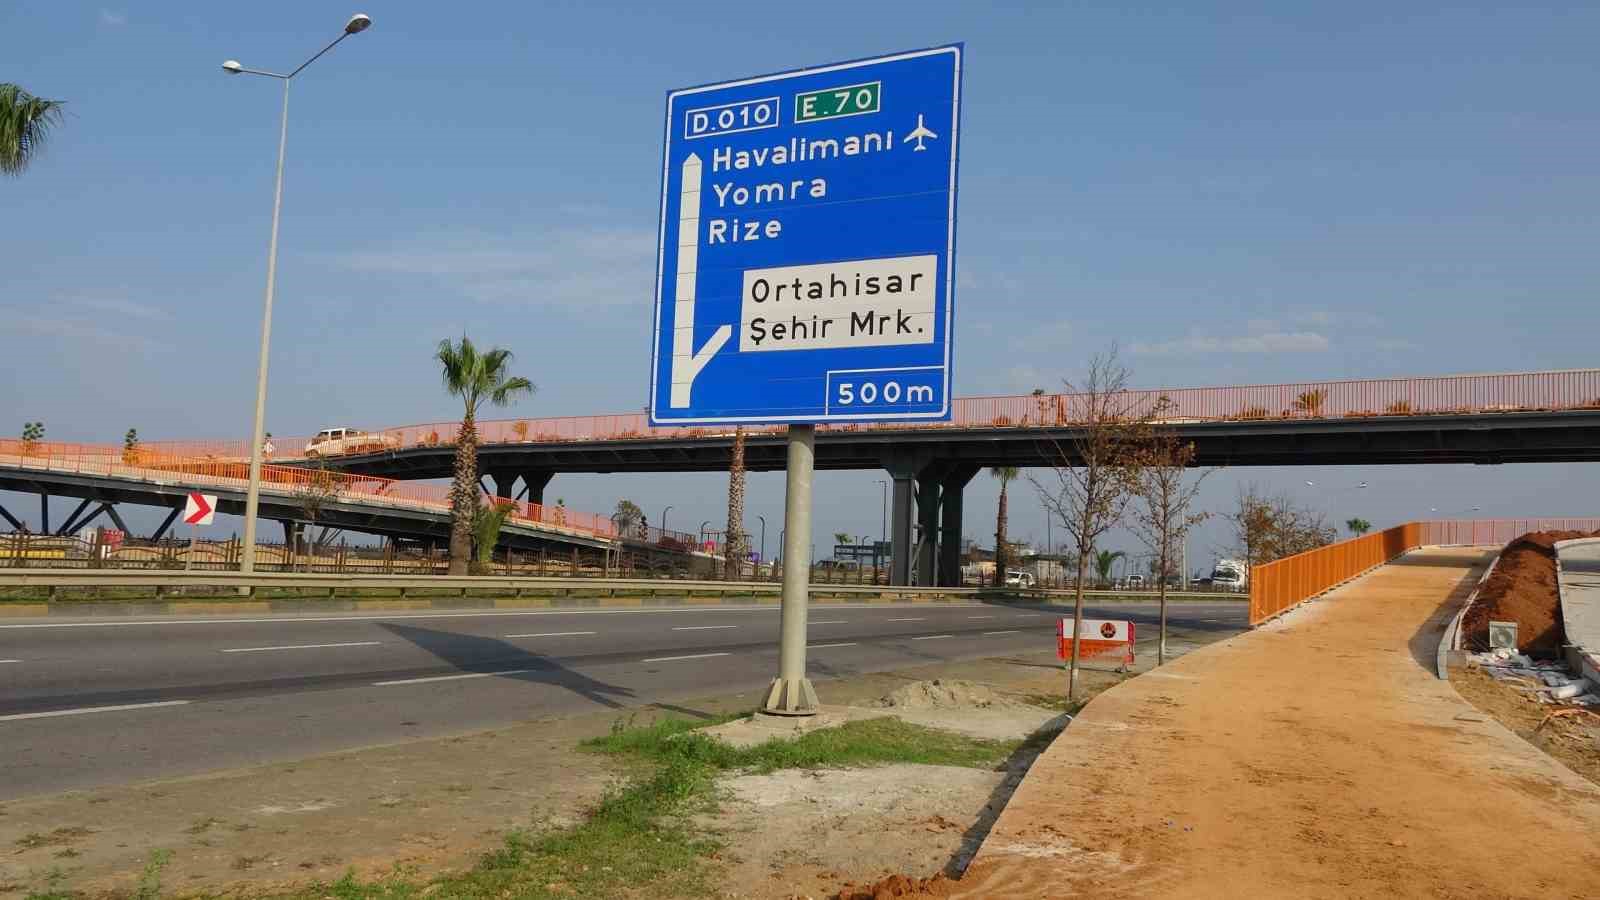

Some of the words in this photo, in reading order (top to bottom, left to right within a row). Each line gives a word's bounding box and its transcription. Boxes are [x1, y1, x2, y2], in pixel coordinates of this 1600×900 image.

[803, 88, 872, 117] E.70
[693, 104, 771, 133] D.010
[713, 131, 892, 172] Havalimanı
[713, 178, 827, 207] Yomra
[708, 219, 781, 244] Rize
[751, 272, 923, 303] Ortahisar
[750, 315, 833, 345] Şehir
[850, 309, 924, 337] Mrk.
[838, 382, 933, 405] 500m
